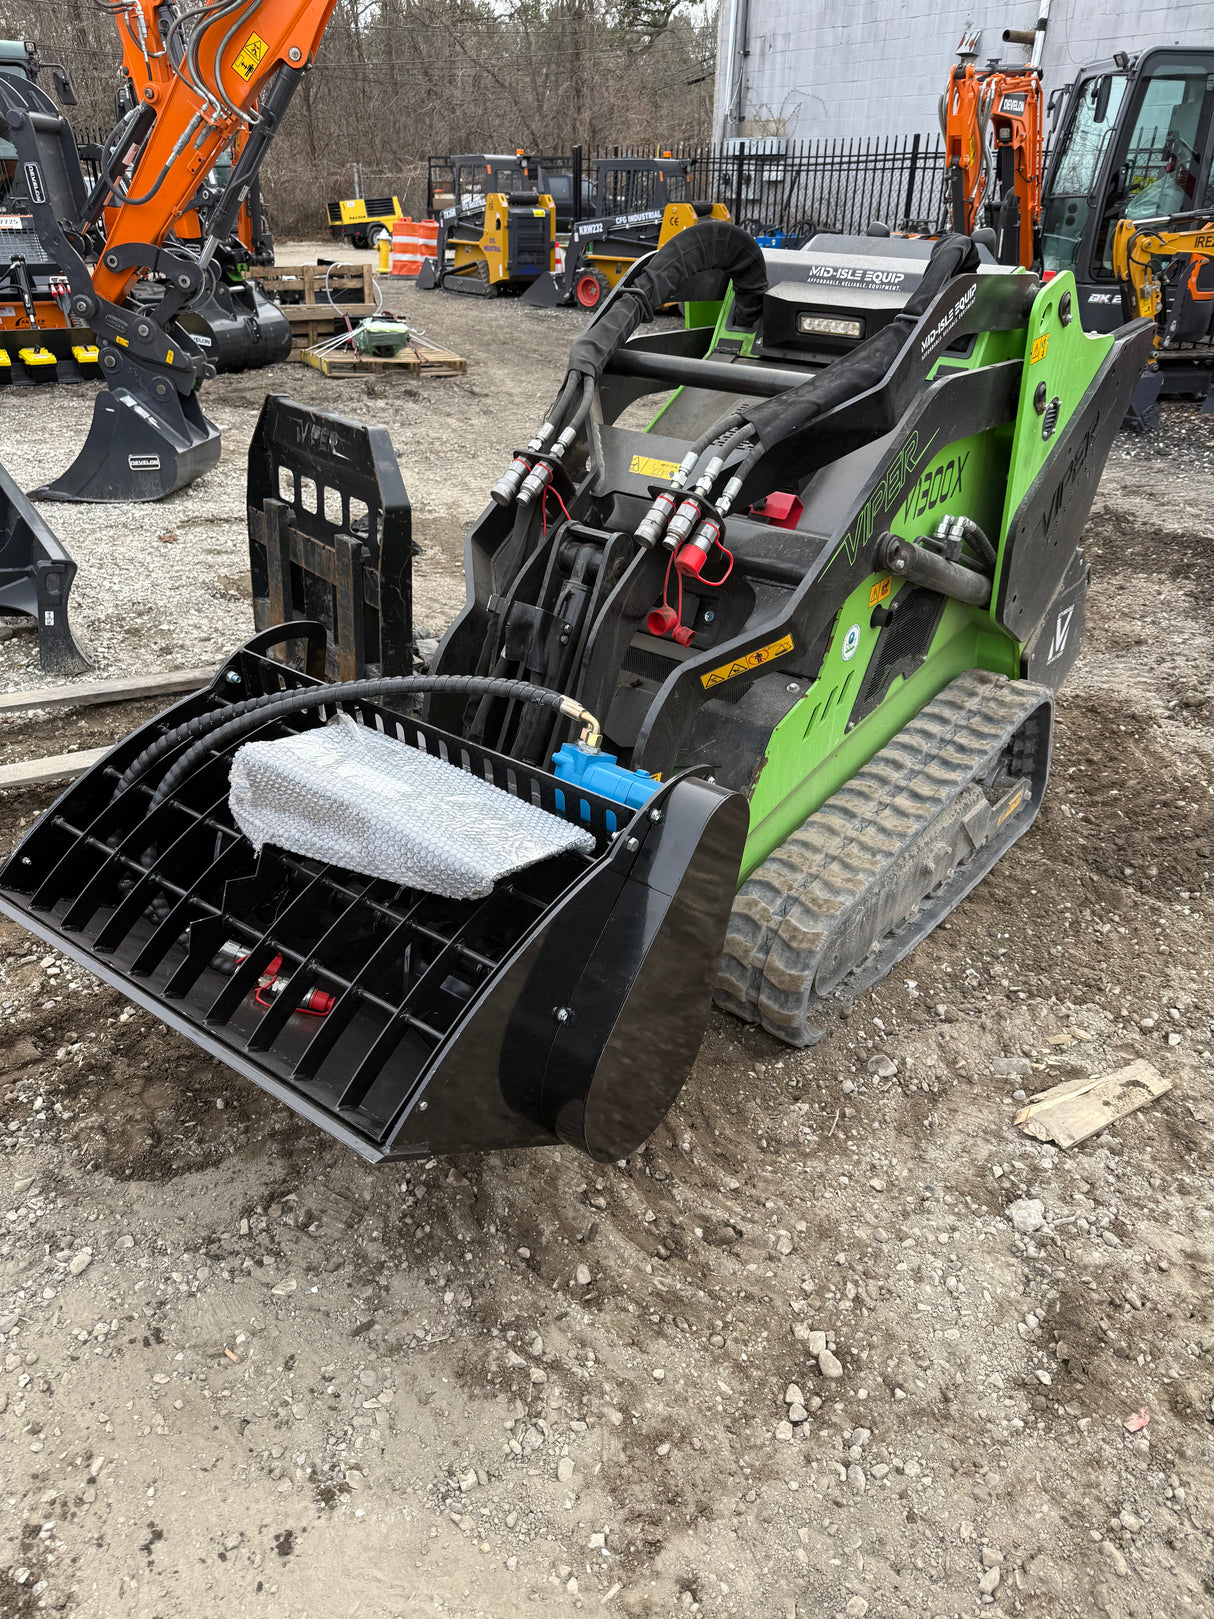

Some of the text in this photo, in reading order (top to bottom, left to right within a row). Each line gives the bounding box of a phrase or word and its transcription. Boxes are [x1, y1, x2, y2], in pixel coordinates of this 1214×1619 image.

[1003, 98, 1025, 112] DEVELON
[28, 165, 42, 203] DEVELON
[615, 210, 662, 225] CFG INDUSTRIAL
[669, 216, 679, 226] CE
[578, 223, 604, 236] KRW232
[1194, 236, 1214, 248] IRE
[809, 265, 905, 284] MID-ISLE EQUIP
[921, 283, 977, 354] MID-ISLE EQUIP
[834, 428, 929, 572] VIPER
